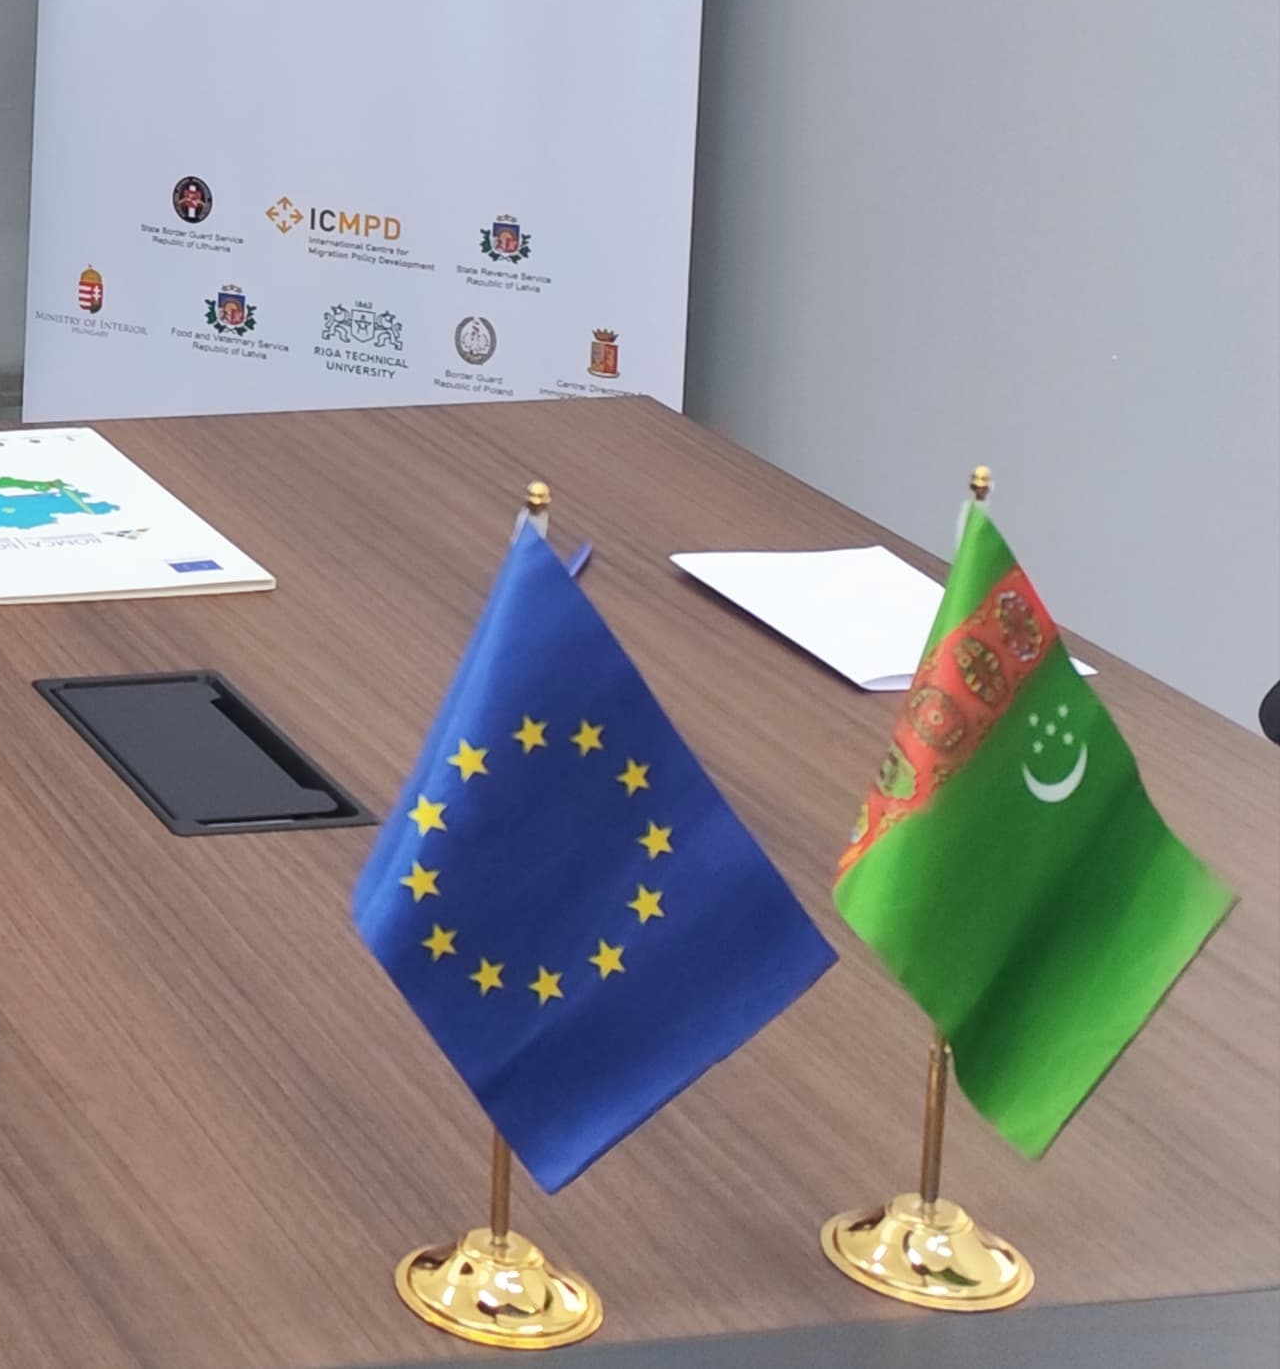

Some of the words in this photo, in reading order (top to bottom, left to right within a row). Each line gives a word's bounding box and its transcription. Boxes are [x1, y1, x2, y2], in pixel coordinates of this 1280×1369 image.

[311, 208, 400, 240] ICMPD
[309, 237, 363, 249] International
[309, 247, 348, 257] Migration
[352, 252, 376, 264] Policy
[379, 256, 434, 270] Development
[171, 327, 192, 338] Food
[314, 346, 341, 358] RIGA
[346, 350, 408, 369] TECHNICAL
[326, 361, 395, 378] UNIVERSITY
